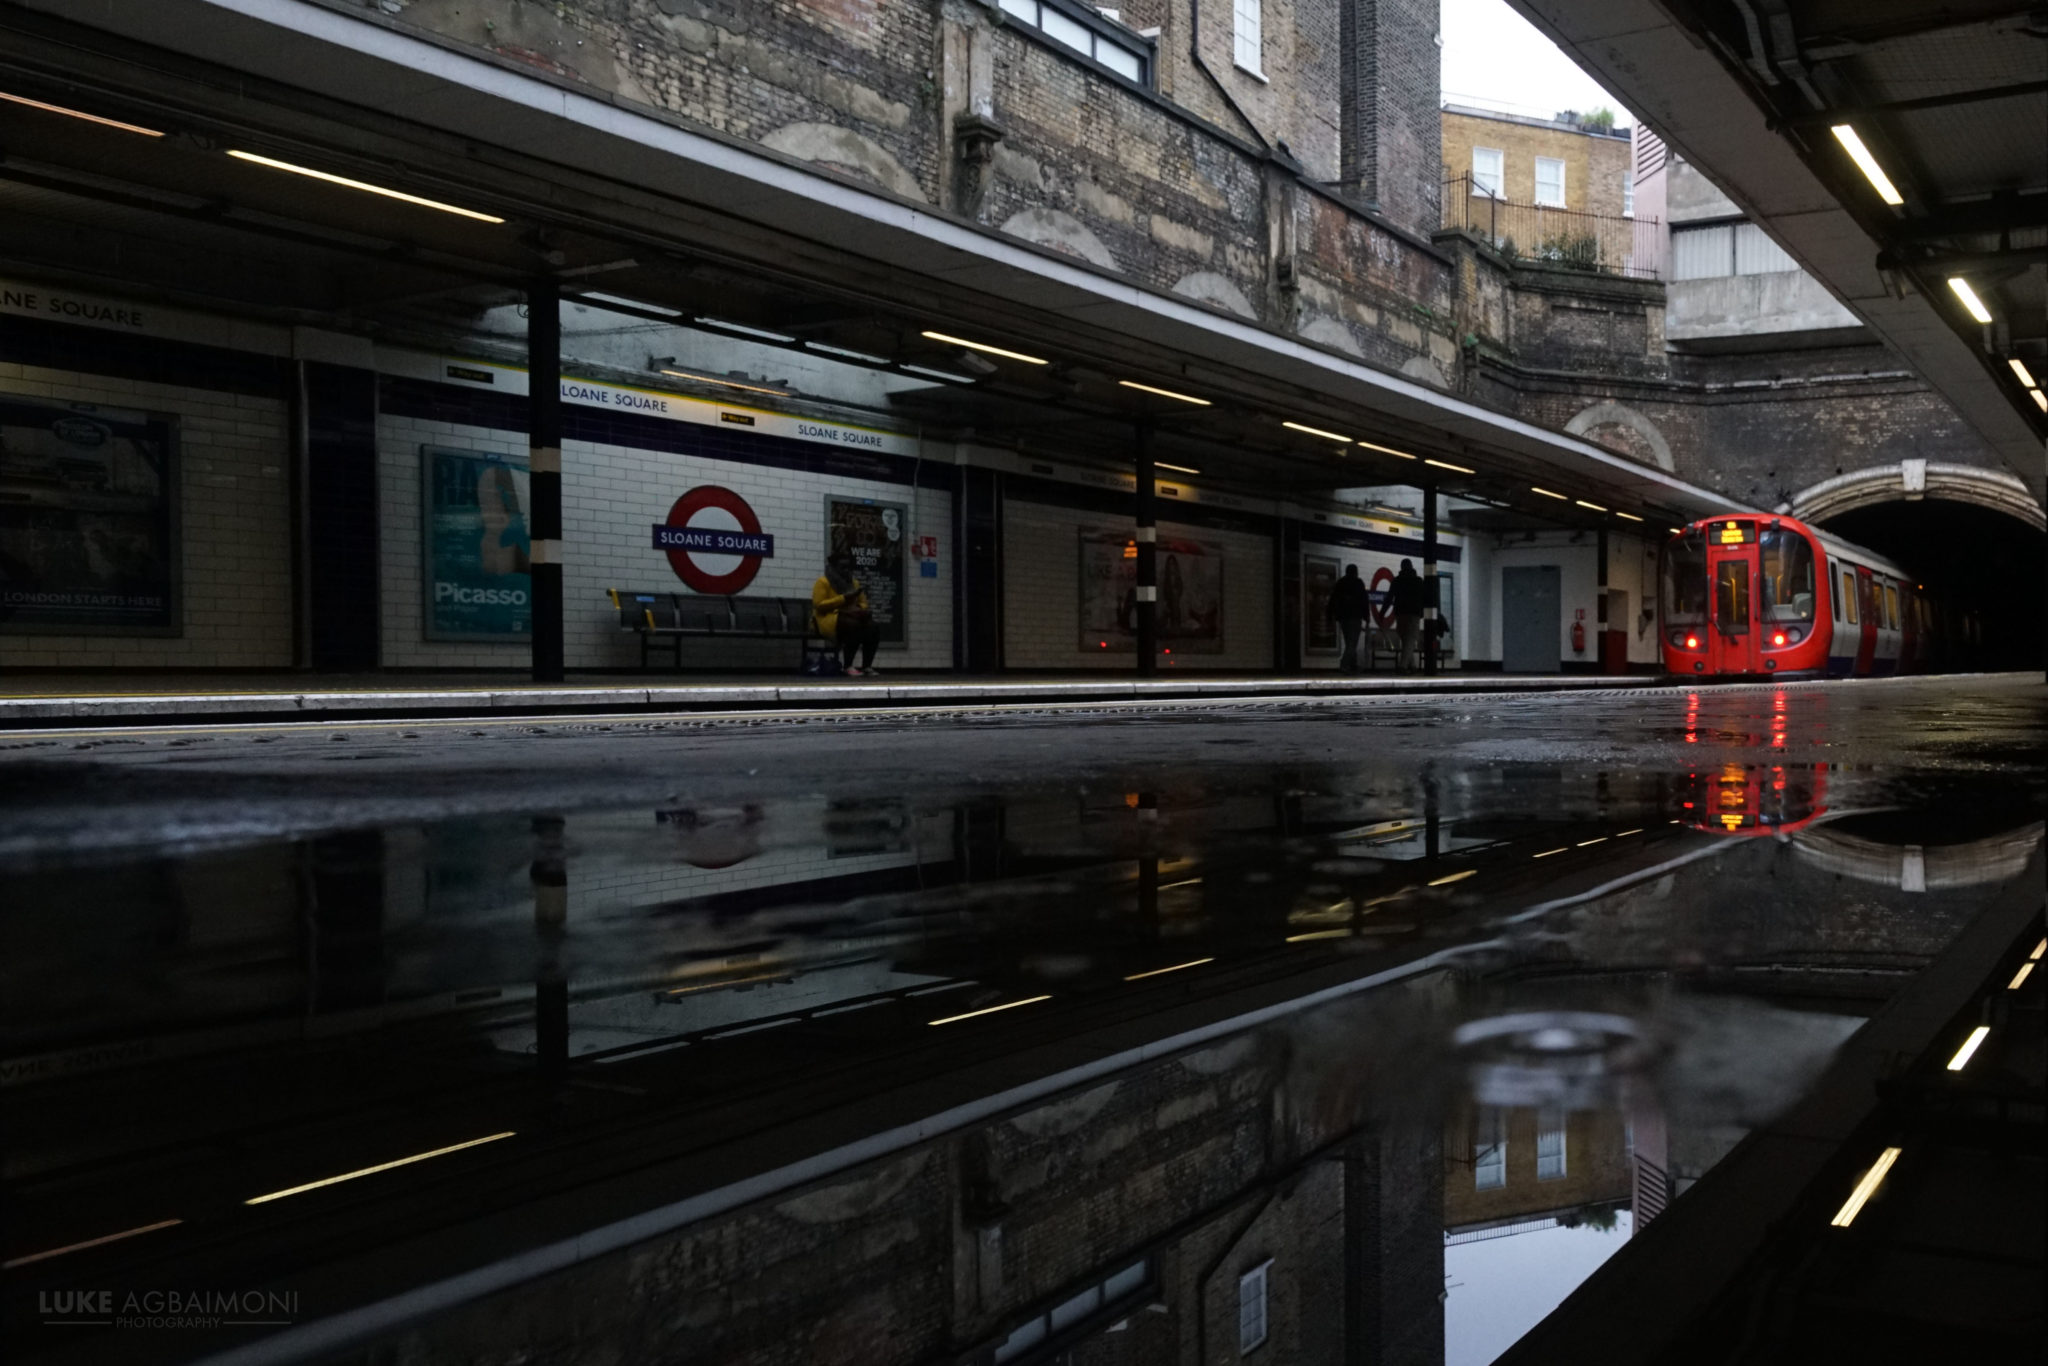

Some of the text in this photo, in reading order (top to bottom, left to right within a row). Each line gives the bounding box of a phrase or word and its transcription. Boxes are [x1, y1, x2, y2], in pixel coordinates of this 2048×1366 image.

[0, 291, 143, 327] NE SQUARE
[562, 386, 668, 412] LOANE SQUARE
[798, 425, 882, 447] SLOANE SQUARE
[660, 531, 767, 551] SLOANE SQUARE
[851, 547, 881, 558] WE ARE
[4, 591, 163, 607] LONDON STARTS HERE
[434, 582, 527, 606] Picasso
